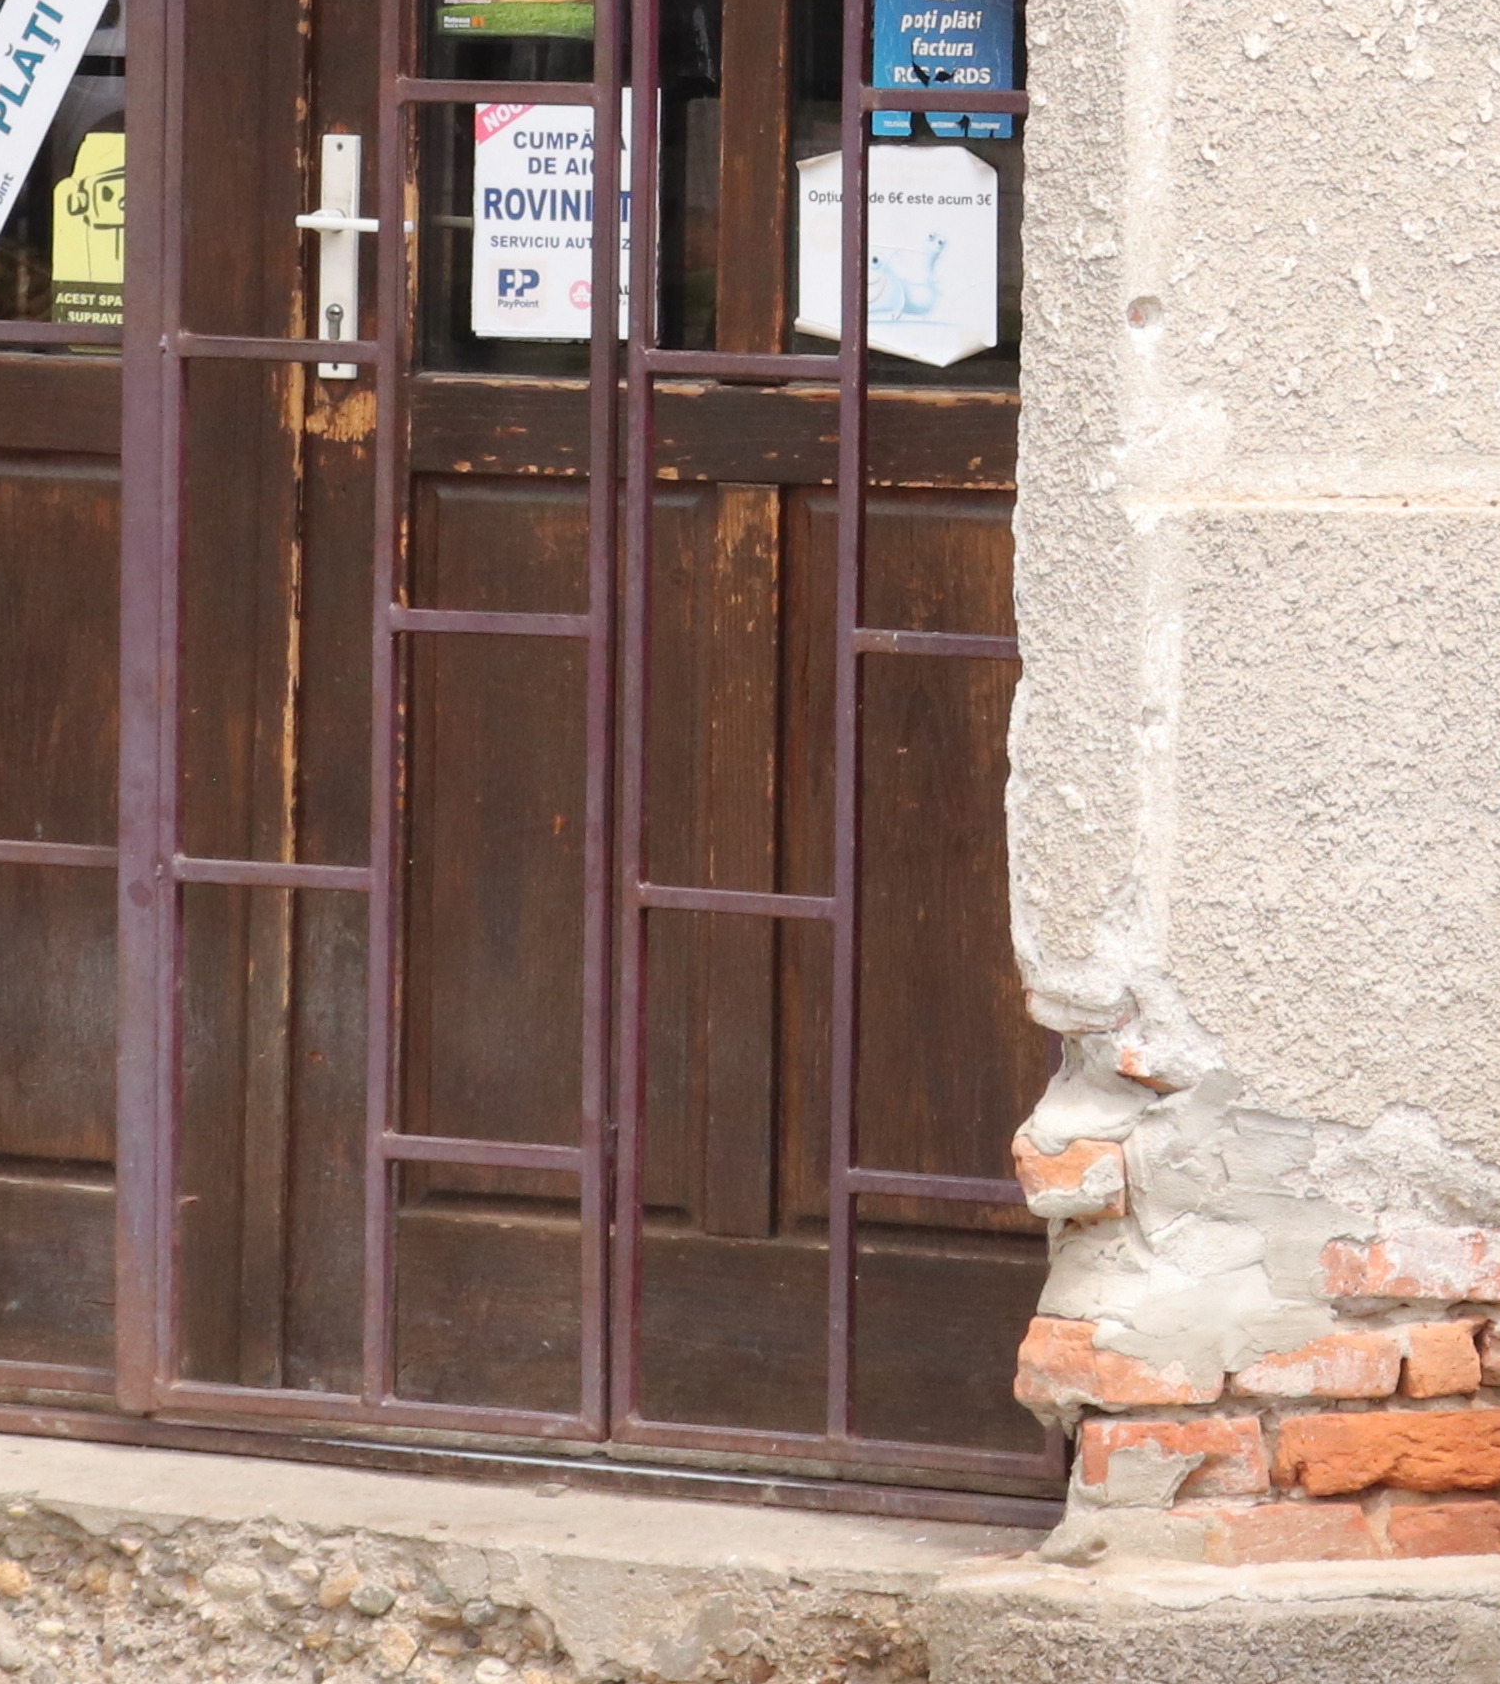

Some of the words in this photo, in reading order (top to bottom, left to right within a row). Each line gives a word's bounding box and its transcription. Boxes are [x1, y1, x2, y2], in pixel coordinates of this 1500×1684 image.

[911, 37, 974, 57] factura
[953, 67, 991, 85] RDS
[528, 157, 557, 175] DE
[869, 191, 885, 203] de
[888, 192, 904, 204] 6€
[907, 193, 935, 205] este
[937, 195, 974, 205] acum
[976, 194, 992, 206] 3€
[490, 236, 560, 249] SERVICIU
[55, 292, 97, 305] ACEST
[98, 294, 124, 306] SPA
[497, 299, 540, 310] PayPoint
[67, 310, 124, 325] SUPRAVE
